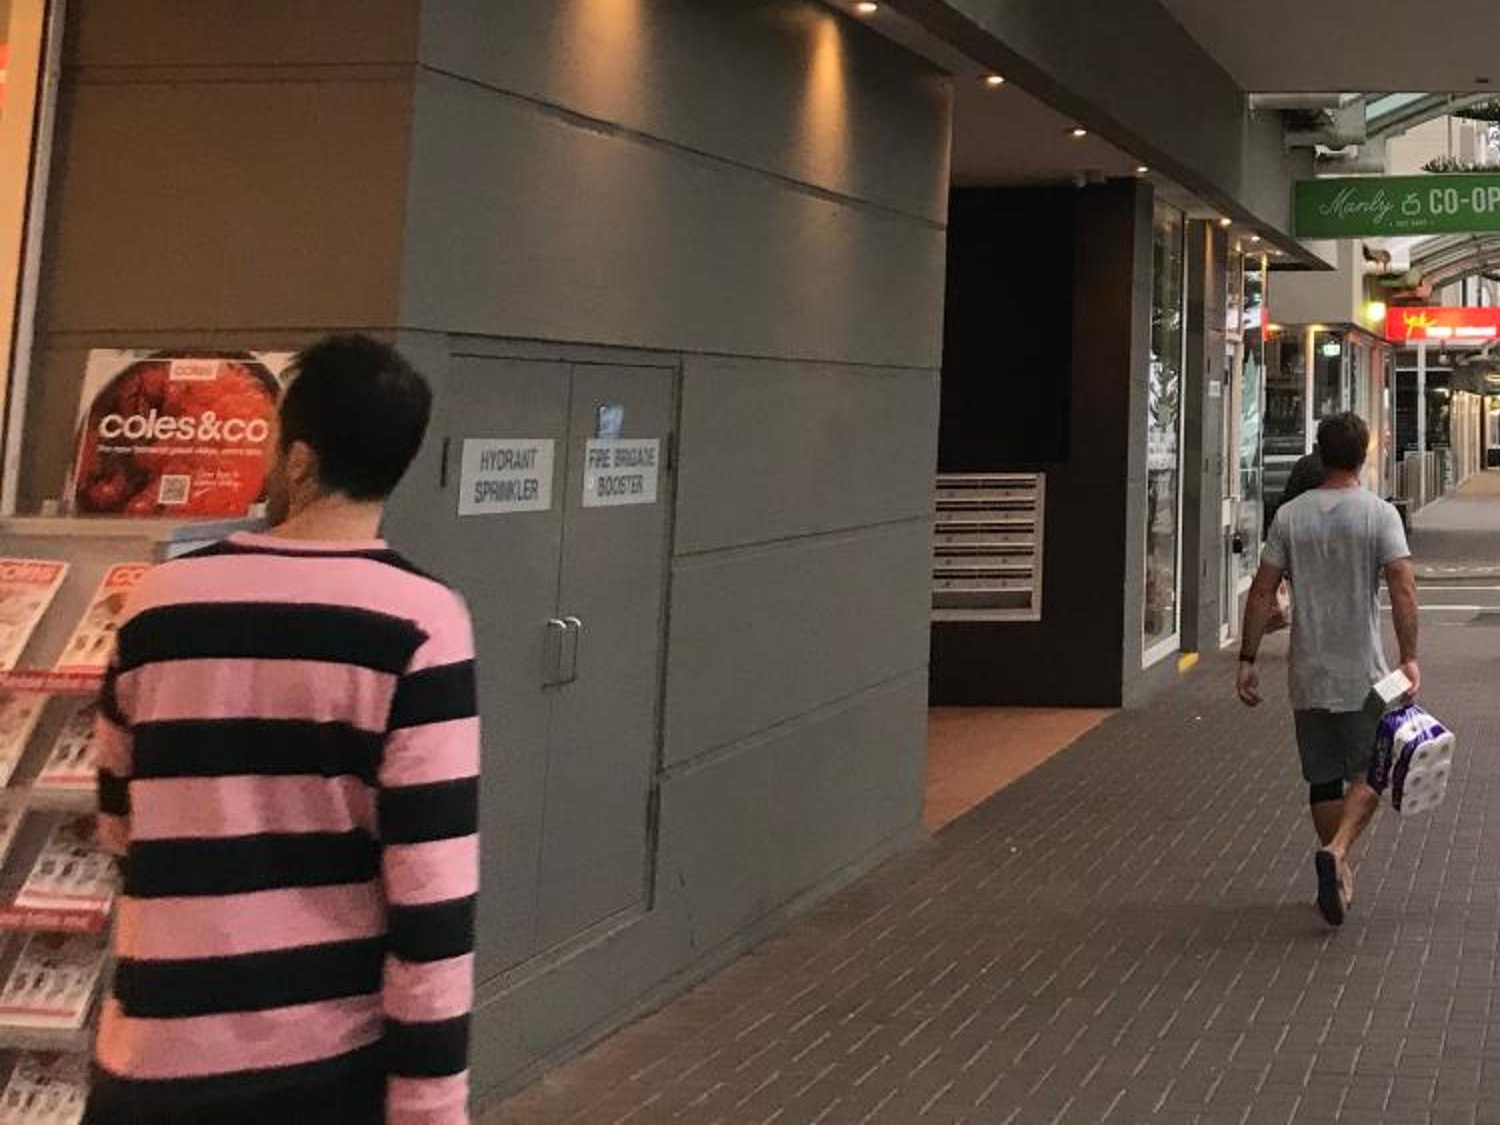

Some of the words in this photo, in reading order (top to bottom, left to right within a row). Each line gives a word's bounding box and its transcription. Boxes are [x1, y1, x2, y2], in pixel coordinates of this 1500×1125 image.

[1318, 187, 1396, 223] Manly
[100, 409, 269, 442] coles&co
[480, 448, 538, 472] HYDRANT
[589, 448, 611, 468] FIRE
[614, 447, 656, 468] BRIGADE
[474, 479, 539, 504] SPRINKLER
[596, 475, 644, 496] BOOSTER
